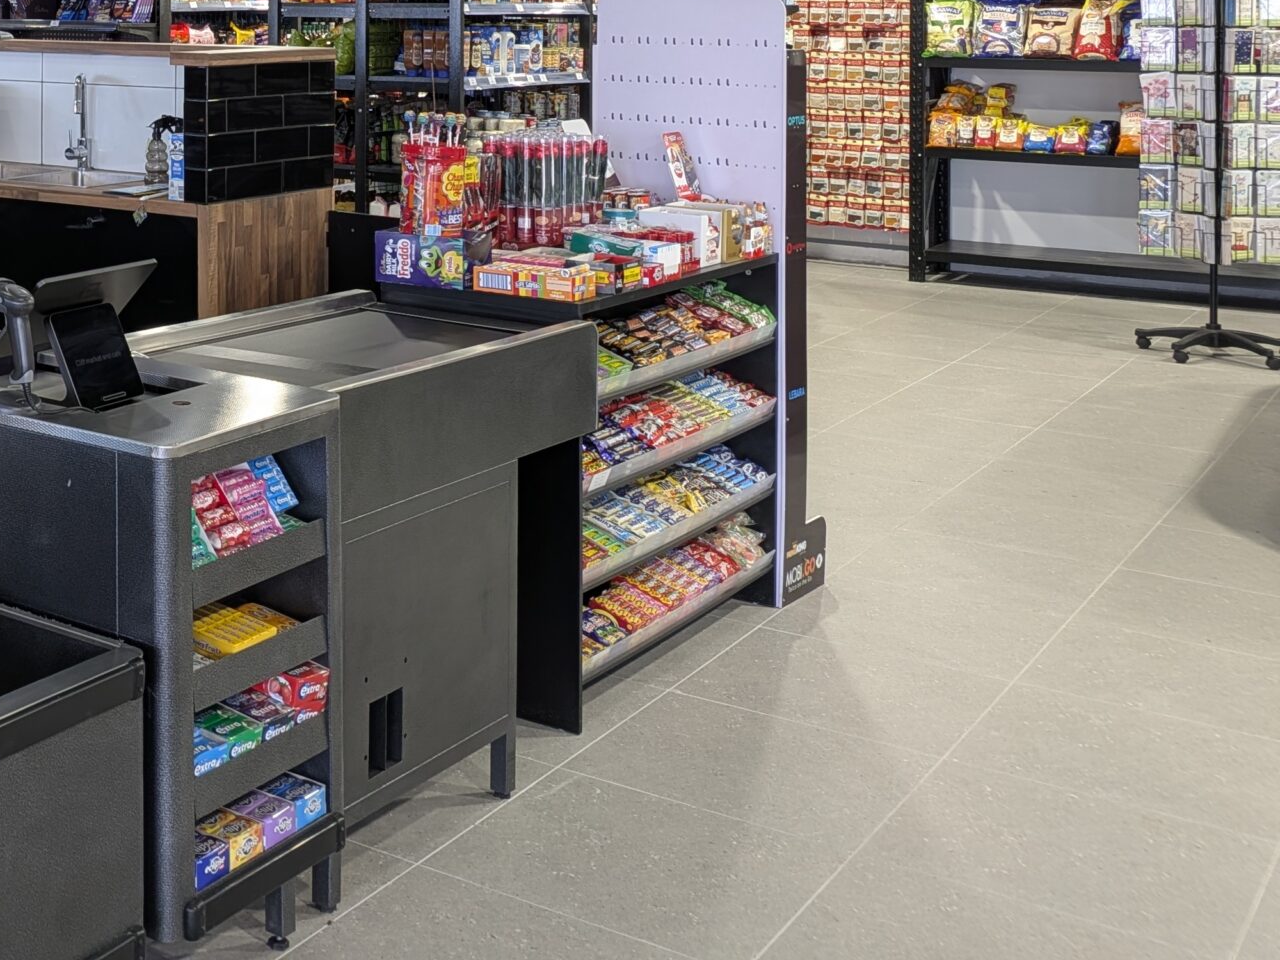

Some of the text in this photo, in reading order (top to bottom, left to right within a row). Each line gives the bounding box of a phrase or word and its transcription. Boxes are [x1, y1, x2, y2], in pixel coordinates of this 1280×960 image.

[788, 115, 805, 126] OPTUS
[399, 241, 410, 277] Freddo
[300, 683, 320, 697] extra
[297, 711, 319, 724] extra
[266, 726, 288, 741] extra
[231, 743, 252, 758] extra
[194, 758, 218, 776] extra
